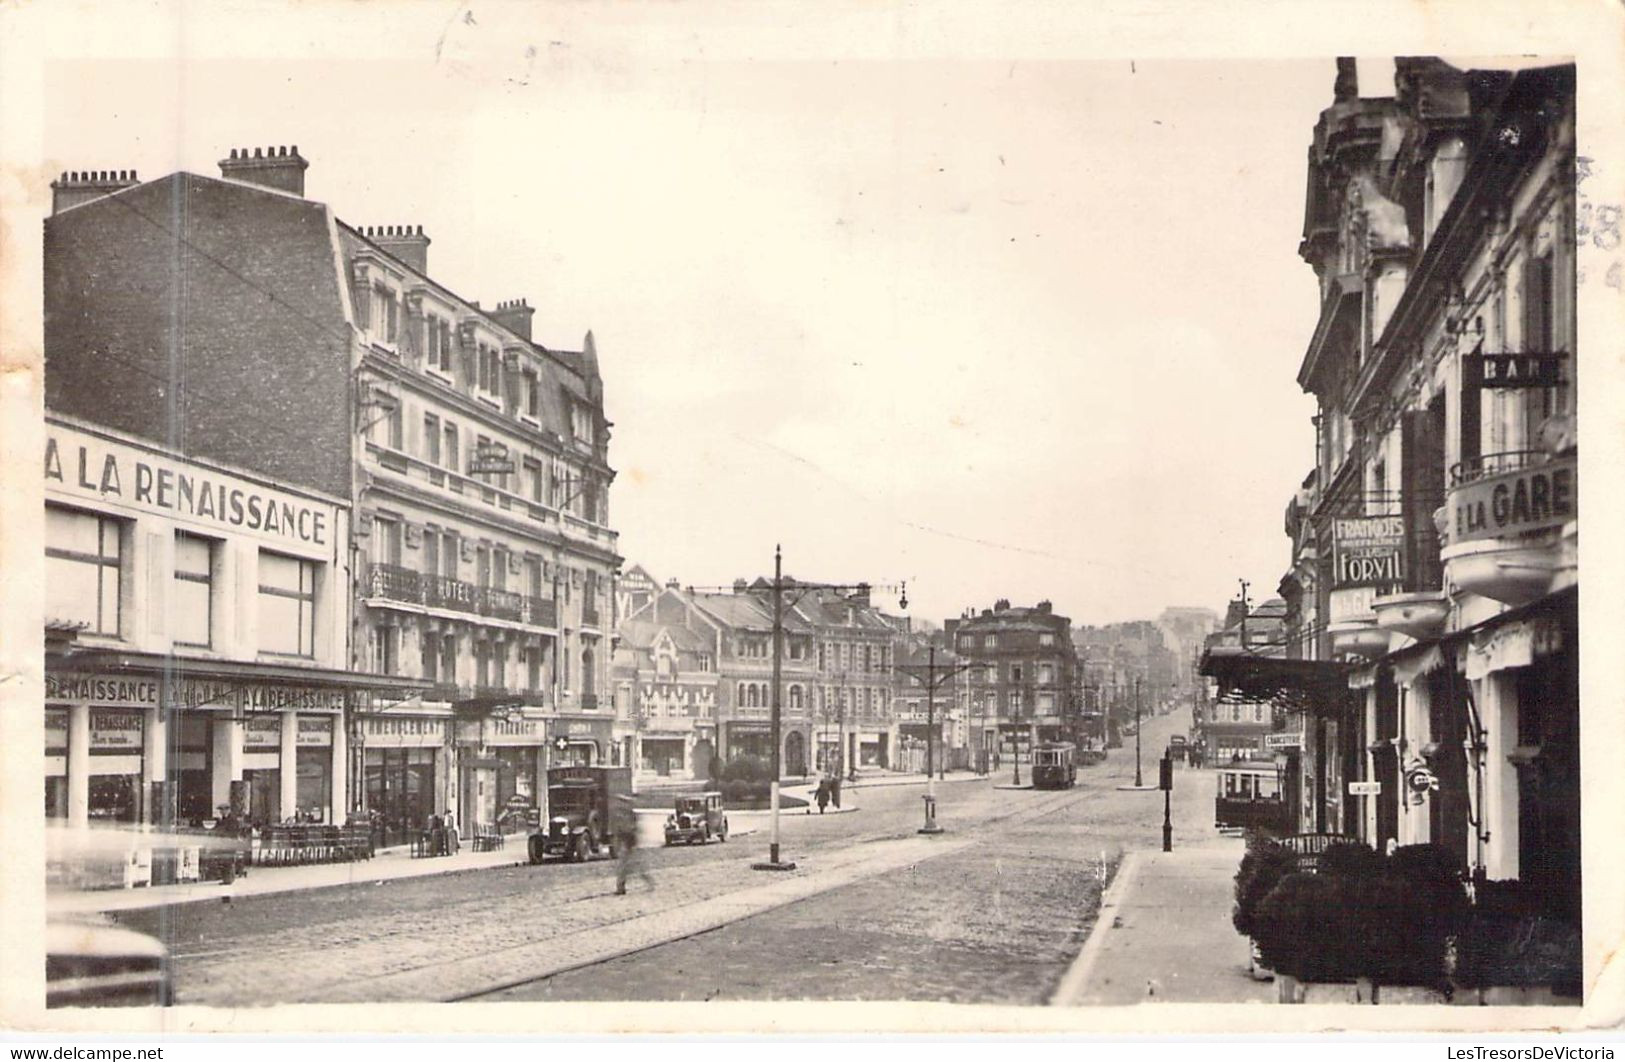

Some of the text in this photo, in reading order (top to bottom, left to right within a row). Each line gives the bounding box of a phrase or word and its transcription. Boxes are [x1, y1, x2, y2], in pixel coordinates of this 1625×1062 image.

[45, 438, 326, 546] A LA RENAISSANCE
[1467, 501, 1487, 533] LA
[1492, 468, 1571, 528] GARE
[1340, 551, 1401, 581] FORVIL
[46, 677, 156, 703] RENAISSANCE
